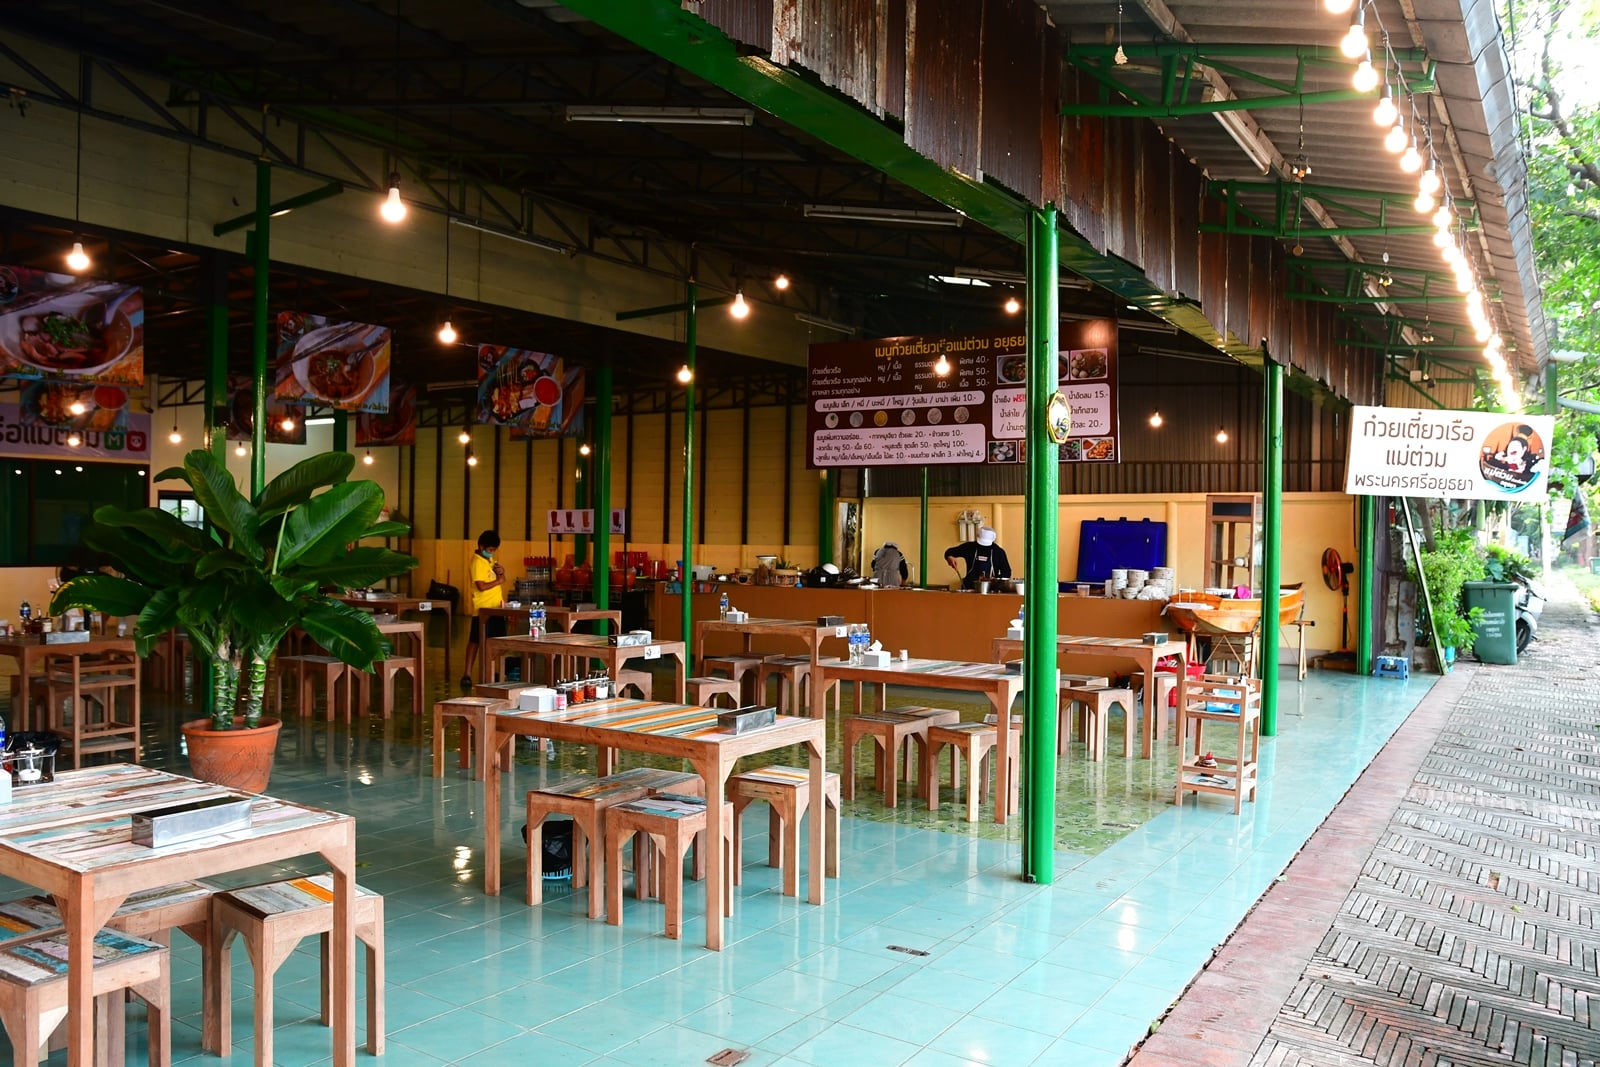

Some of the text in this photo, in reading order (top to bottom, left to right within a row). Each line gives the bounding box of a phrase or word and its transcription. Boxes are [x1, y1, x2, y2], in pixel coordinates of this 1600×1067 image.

[994, 335, 1026, 352] อยุธย
[1006, 422, 1026, 433] น้ำมะตู
[1071, 420, 1086, 429] ก้วละ
[1363, 412, 1475, 442] ก๋วยเตี๋ยวเรือ
[1386, 444, 1448, 469] แม่ต่วม
[1355, 472, 1473, 495] พระนครศรีอยุธยา
